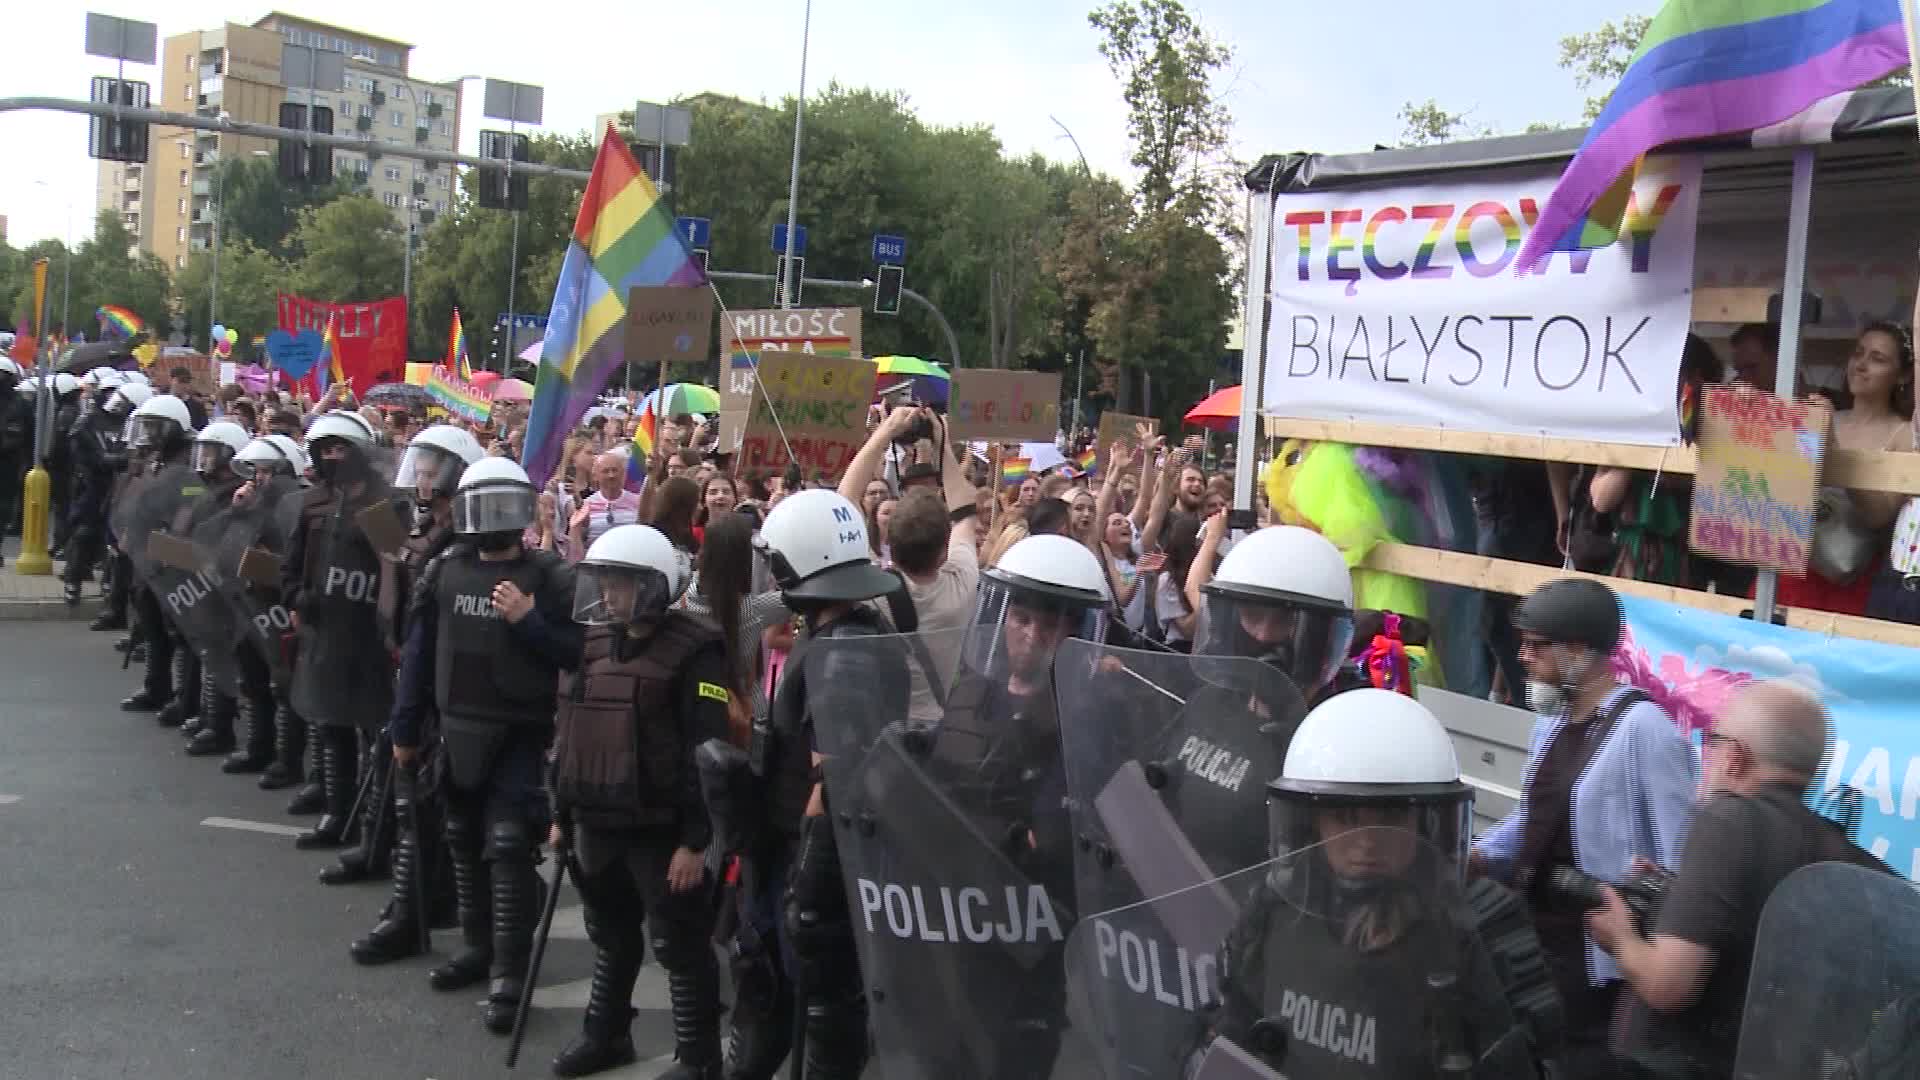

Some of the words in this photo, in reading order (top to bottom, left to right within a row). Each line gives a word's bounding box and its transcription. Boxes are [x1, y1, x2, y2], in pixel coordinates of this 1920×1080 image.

[878, 242, 900, 256] BUS
[735, 309, 846, 337] MIŁOŚĆ
[1288, 315, 1653, 395] BIAŁYSTOK
[832, 506, 852, 523] M
[1177, 735, 1251, 792] POLICJA
[857, 878, 1065, 944] POLICJA
[1280, 988, 1377, 1065] POLICJA
